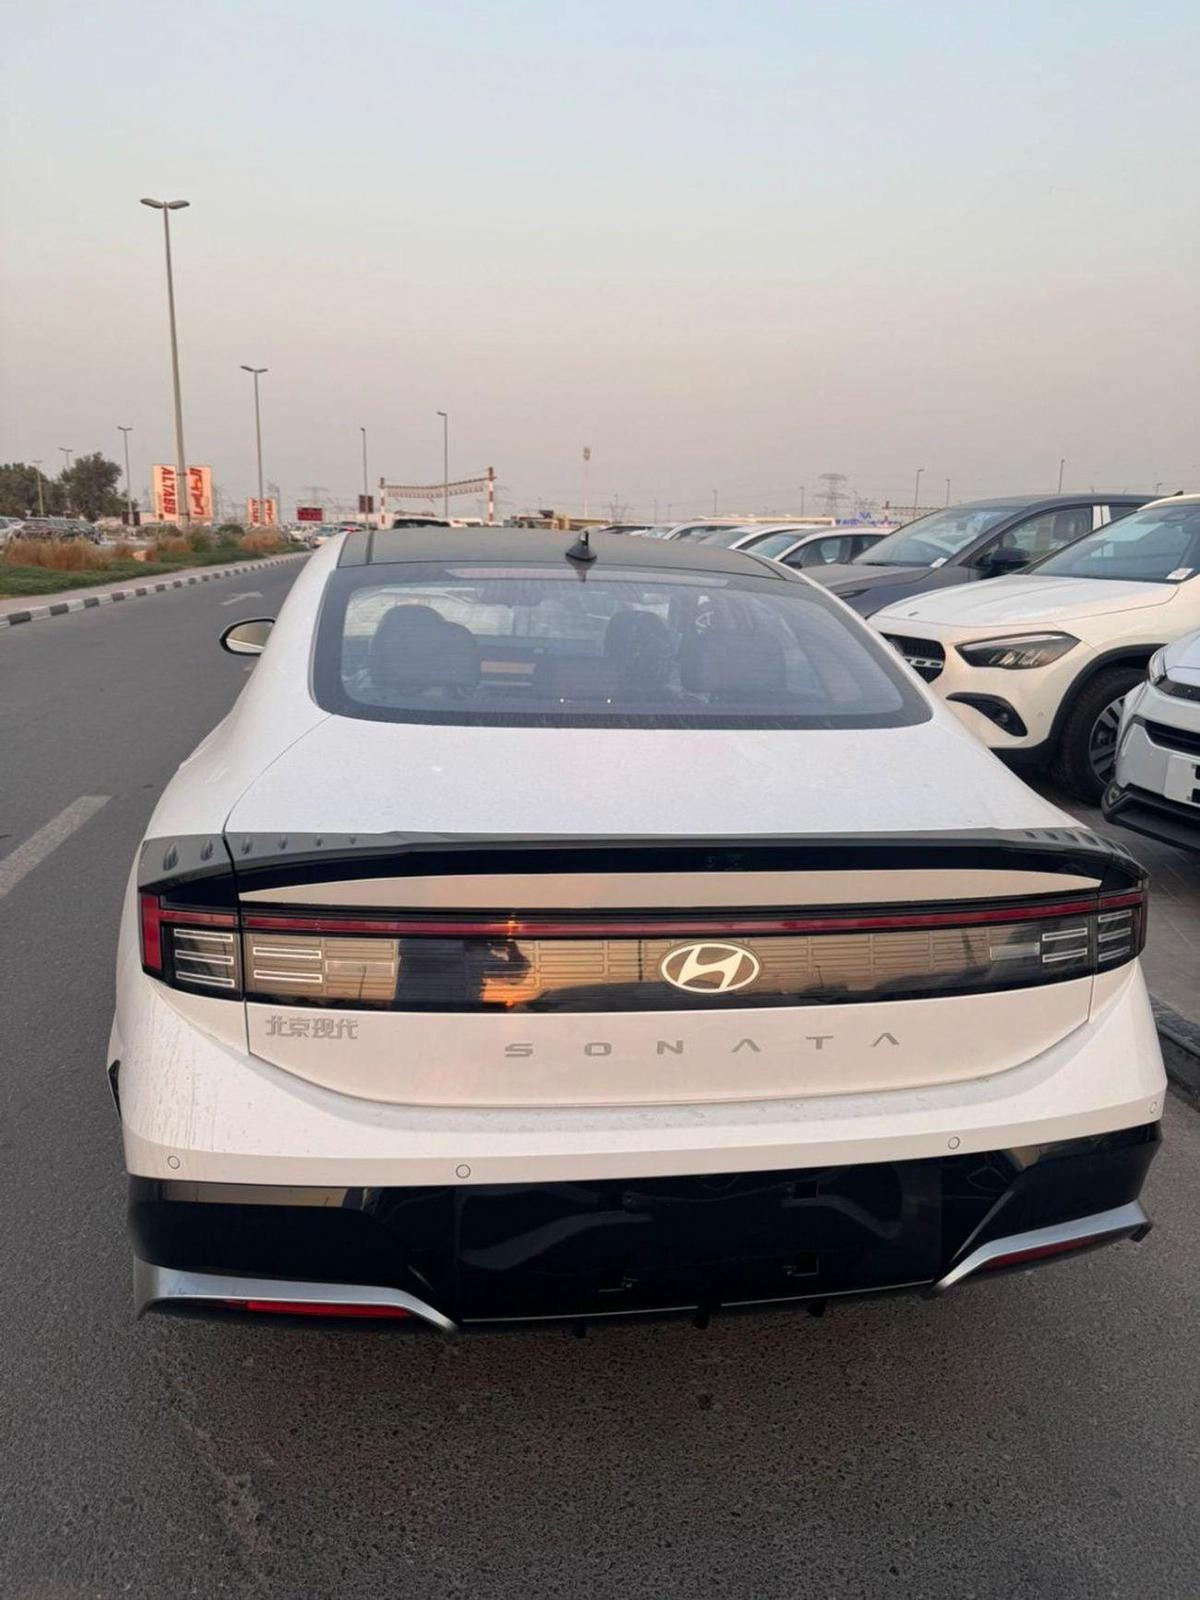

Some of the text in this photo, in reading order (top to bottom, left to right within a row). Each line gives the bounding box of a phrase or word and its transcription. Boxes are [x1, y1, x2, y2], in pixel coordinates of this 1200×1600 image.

[265, 1015, 359, 1039] 北京现代
[504, 1032, 900, 1058] SONATA
